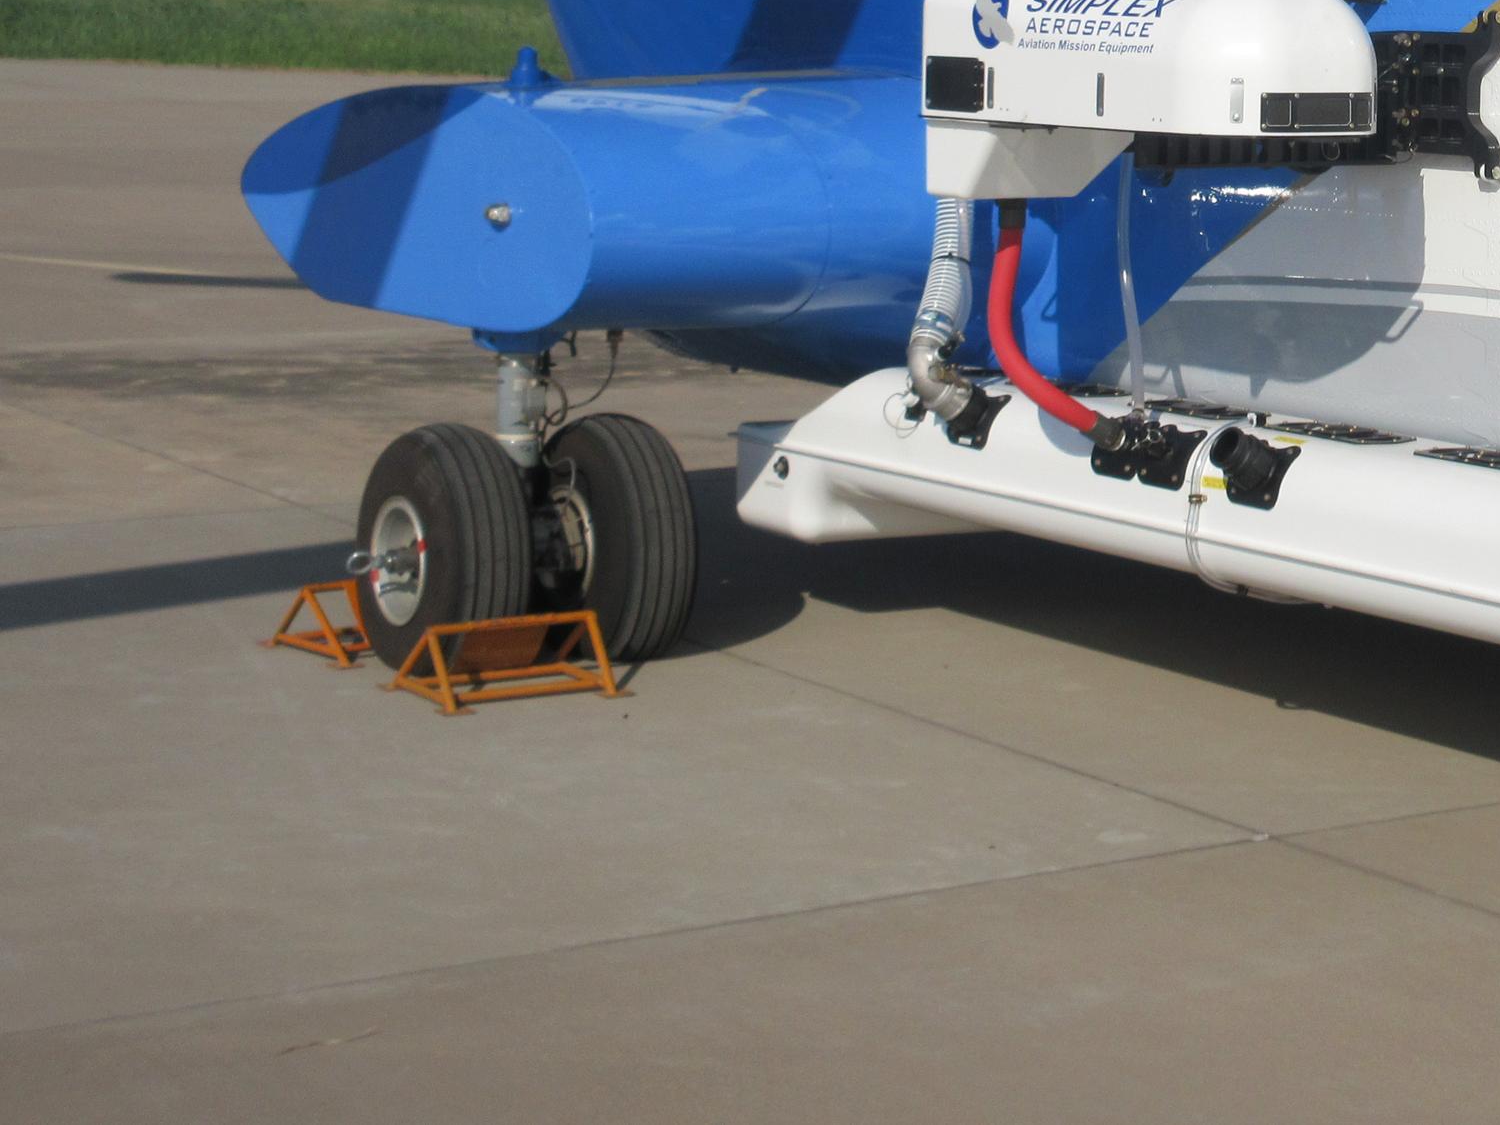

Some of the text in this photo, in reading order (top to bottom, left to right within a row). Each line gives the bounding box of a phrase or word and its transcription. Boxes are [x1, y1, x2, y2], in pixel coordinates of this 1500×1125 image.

[1025, 18, 1154, 38] AEROSPACE
[1018, 38, 1154, 55] Aviation Mission Equipment
